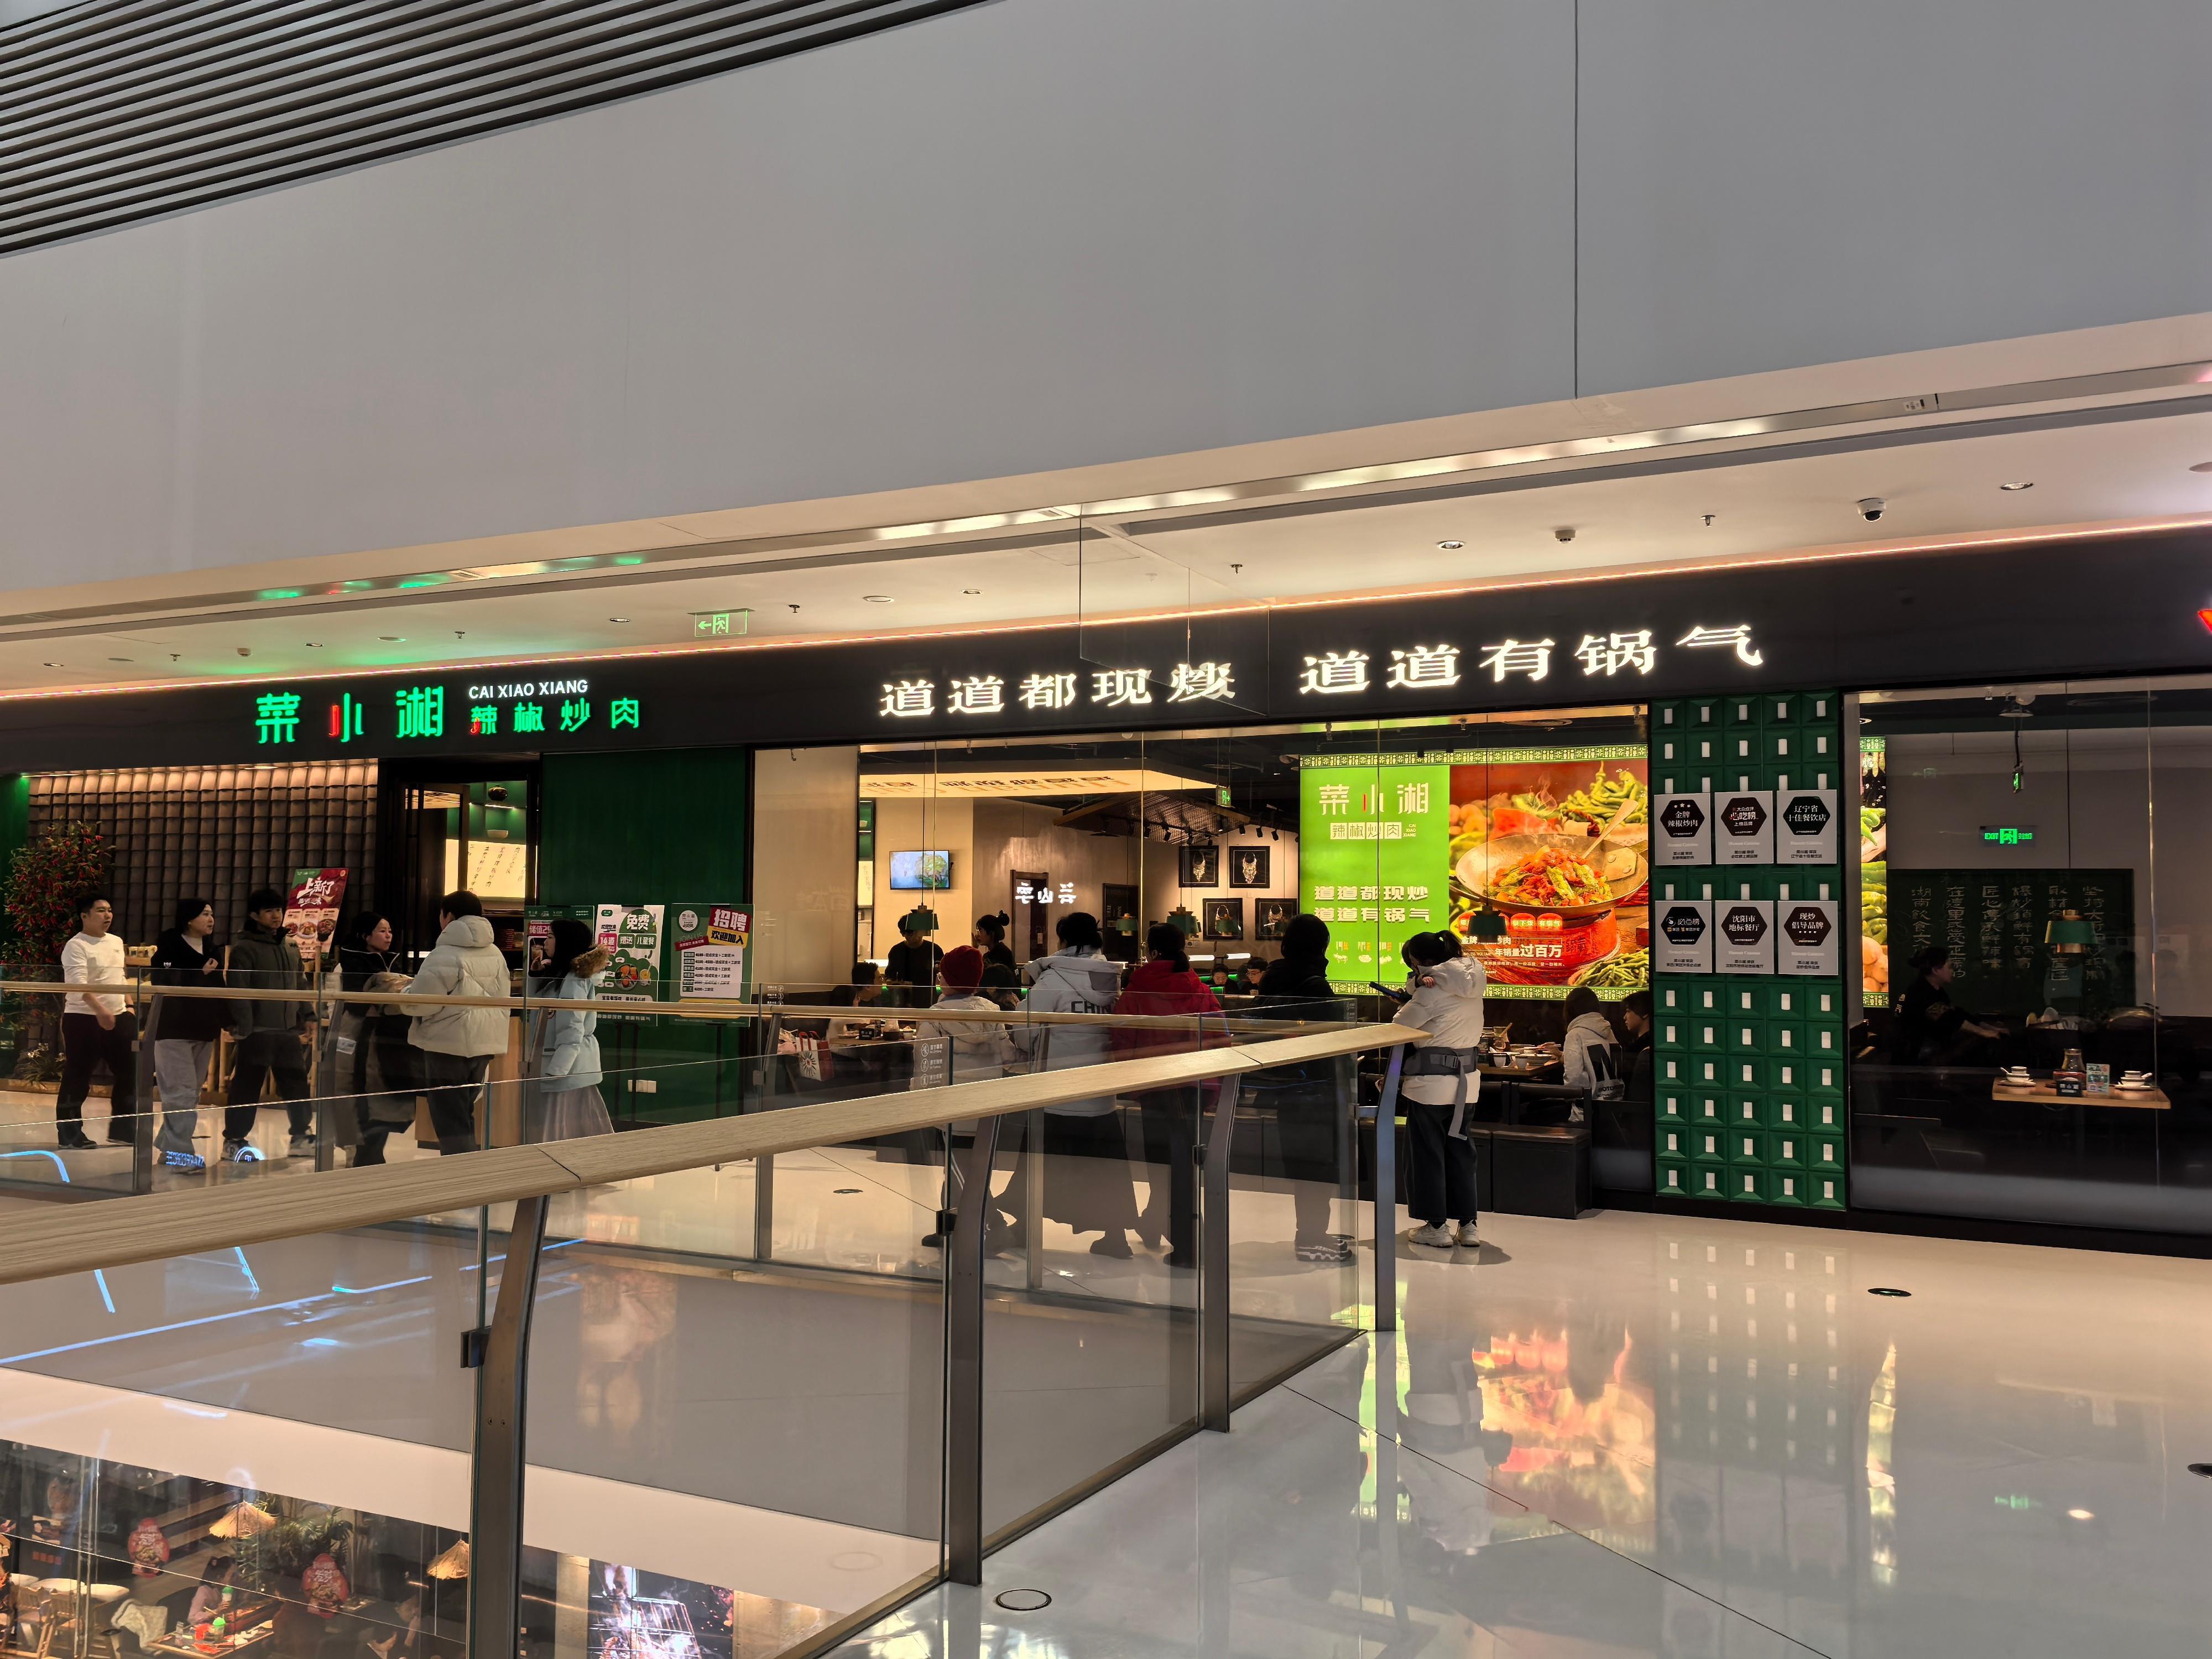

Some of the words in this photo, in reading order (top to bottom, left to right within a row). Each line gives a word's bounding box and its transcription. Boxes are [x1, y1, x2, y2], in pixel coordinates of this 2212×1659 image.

[1299, 624, 1764, 694] 道道有锅气
[469, 685, 494, 700] CAI
[498, 682, 535, 698] XIAO
[539, 679, 588, 695] XIANG
[879, 662, 1234, 717] 道道都现炒
[255, 686, 444, 744] 菜小湘
[470, 697, 640, 735] 辣椒炒肉
[1318, 782, 1430, 815] 菜小湘
[1788, 813, 1827, 822] 十佳餐饮店
[1331, 822, 1401, 839] 辣椒炒肉
[1314, 885, 1428, 901] 道道都现炒
[626, 914, 650, 931] 免费
[713, 909, 747, 932] 招聘
[1314, 907, 1430, 923] 道道有锅气
[1792, 921, 1824, 930] 倡导品牌
[711, 930, 744, 945] 欢迎加入
[1495, 944, 1563, 958] 年销量过百万
